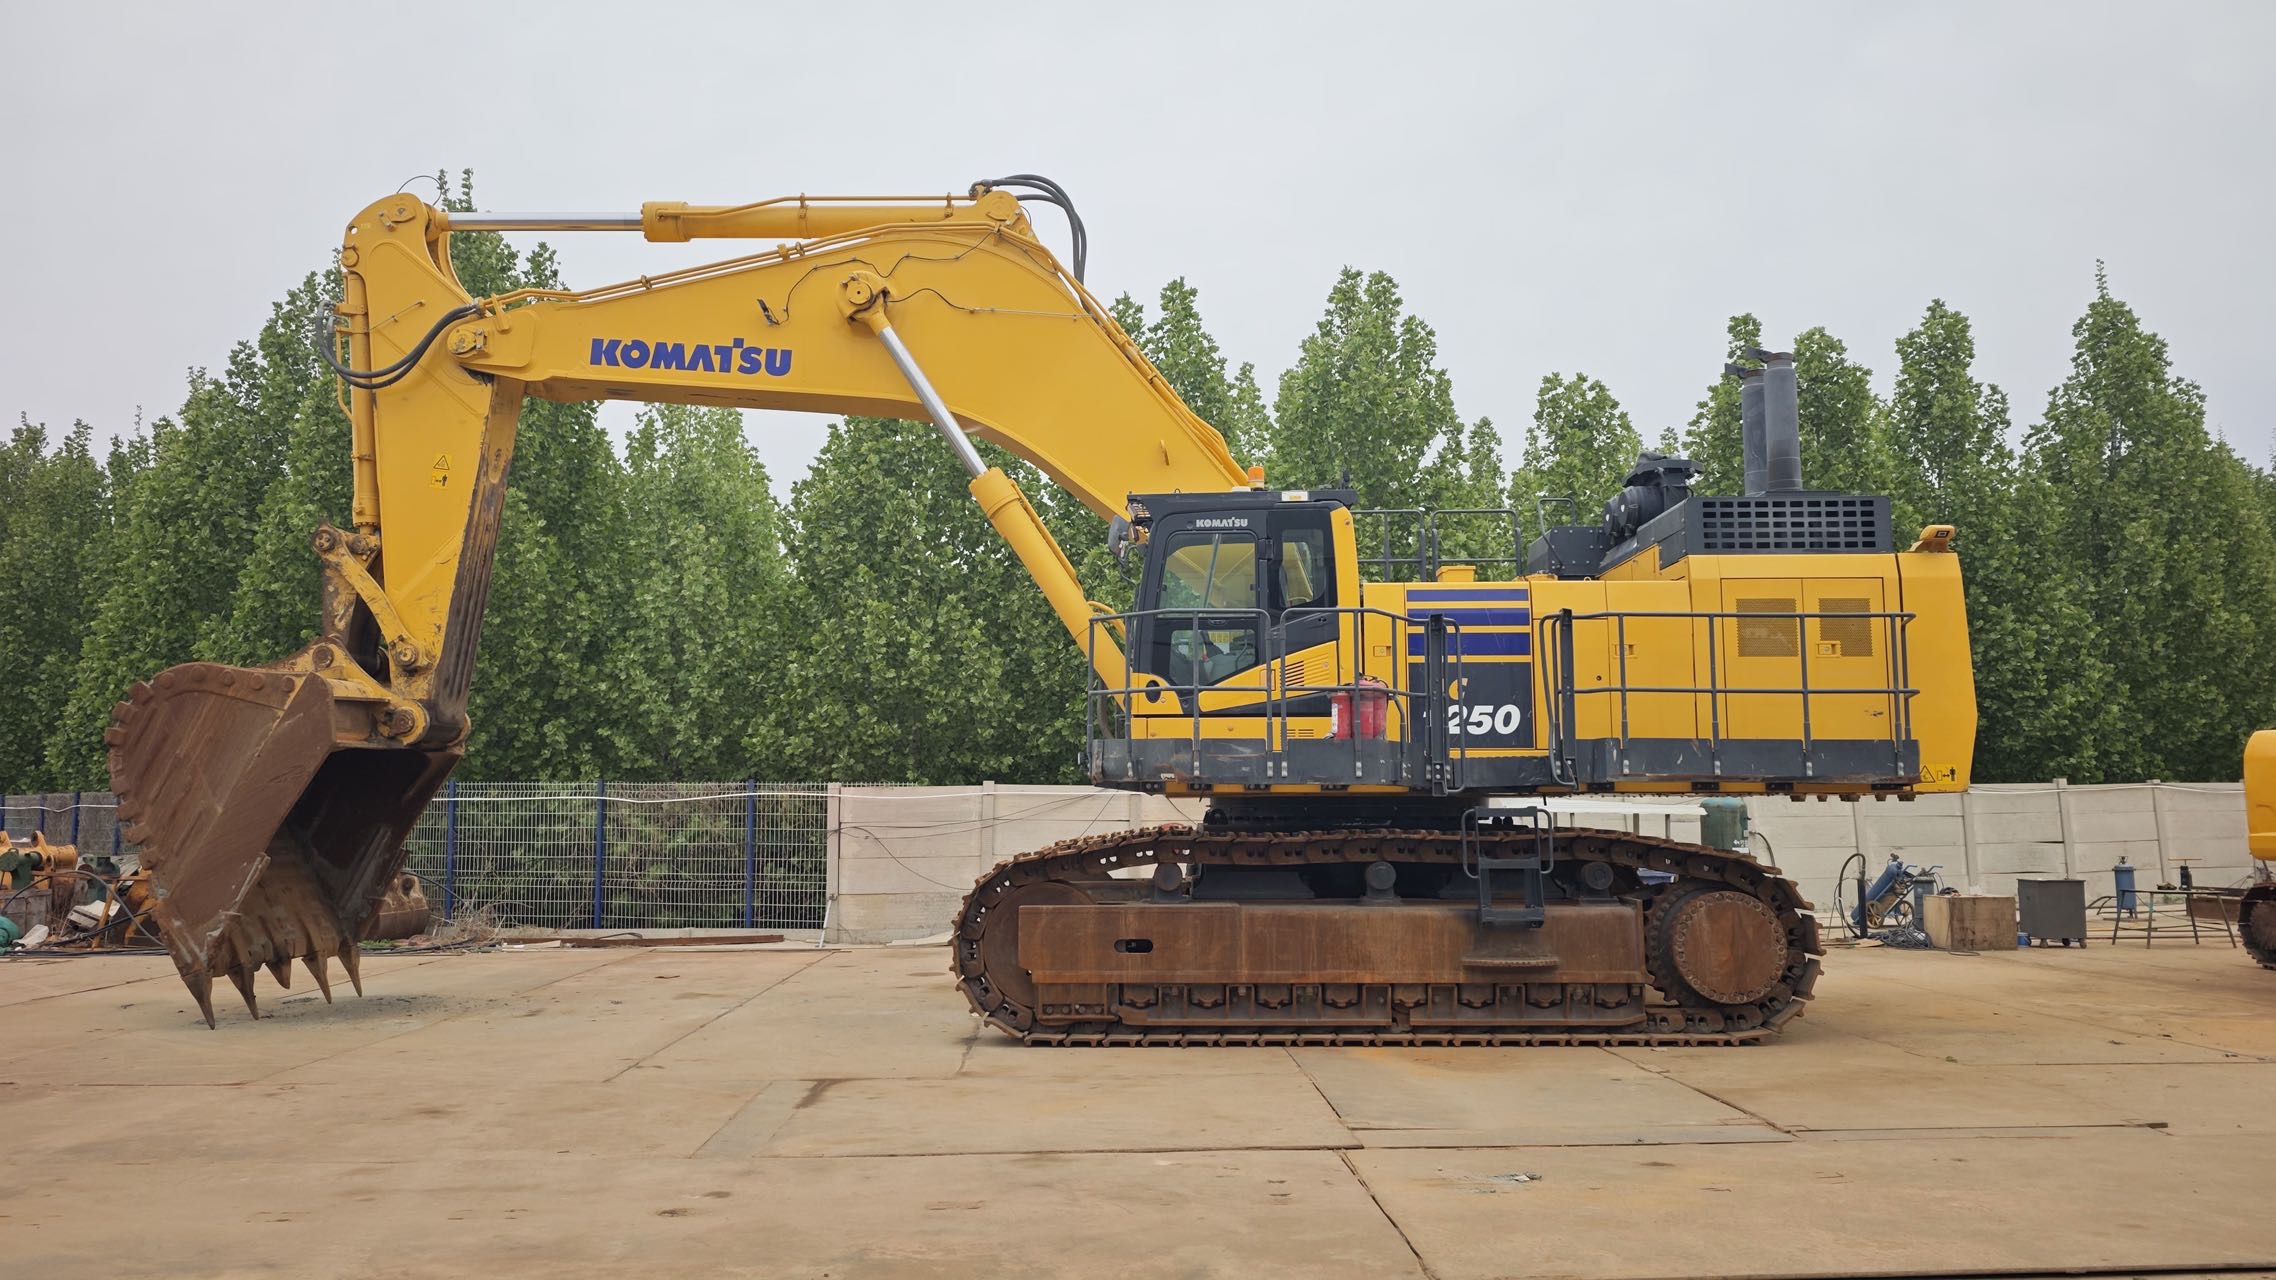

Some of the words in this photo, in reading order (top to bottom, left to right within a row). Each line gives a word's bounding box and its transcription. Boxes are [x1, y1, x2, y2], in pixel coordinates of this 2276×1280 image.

[590, 338, 792, 377] KOMATSU
[1195, 516, 1249, 528] KOMATSU
[1423, 704, 1521, 735] 250
